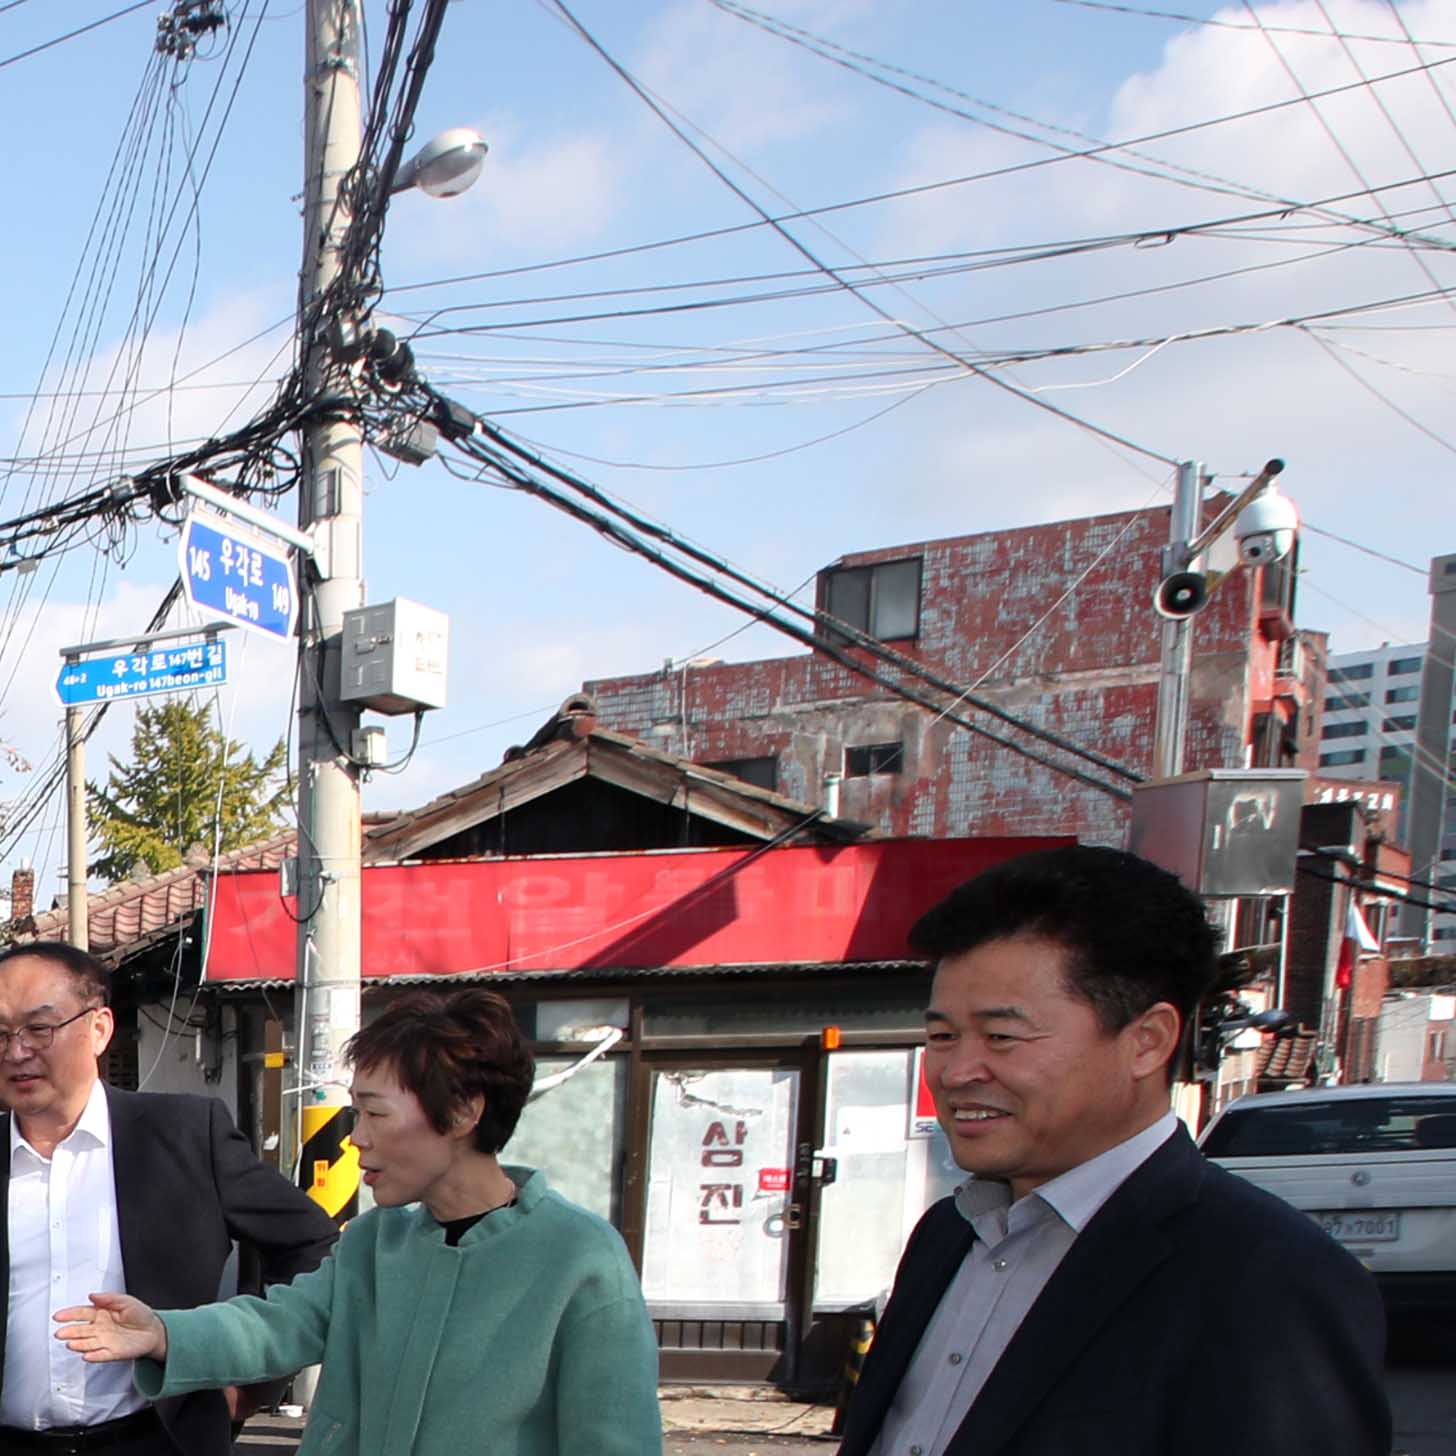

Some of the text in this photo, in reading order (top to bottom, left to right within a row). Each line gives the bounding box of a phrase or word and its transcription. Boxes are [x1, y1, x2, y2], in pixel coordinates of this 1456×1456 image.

[190, 546, 211, 581] 145
[220, 538, 263, 587] 우각로
[225, 586, 259, 621] Ugak-ro
[96, 668, 223, 698] Ugak-ro 147beon-gil
